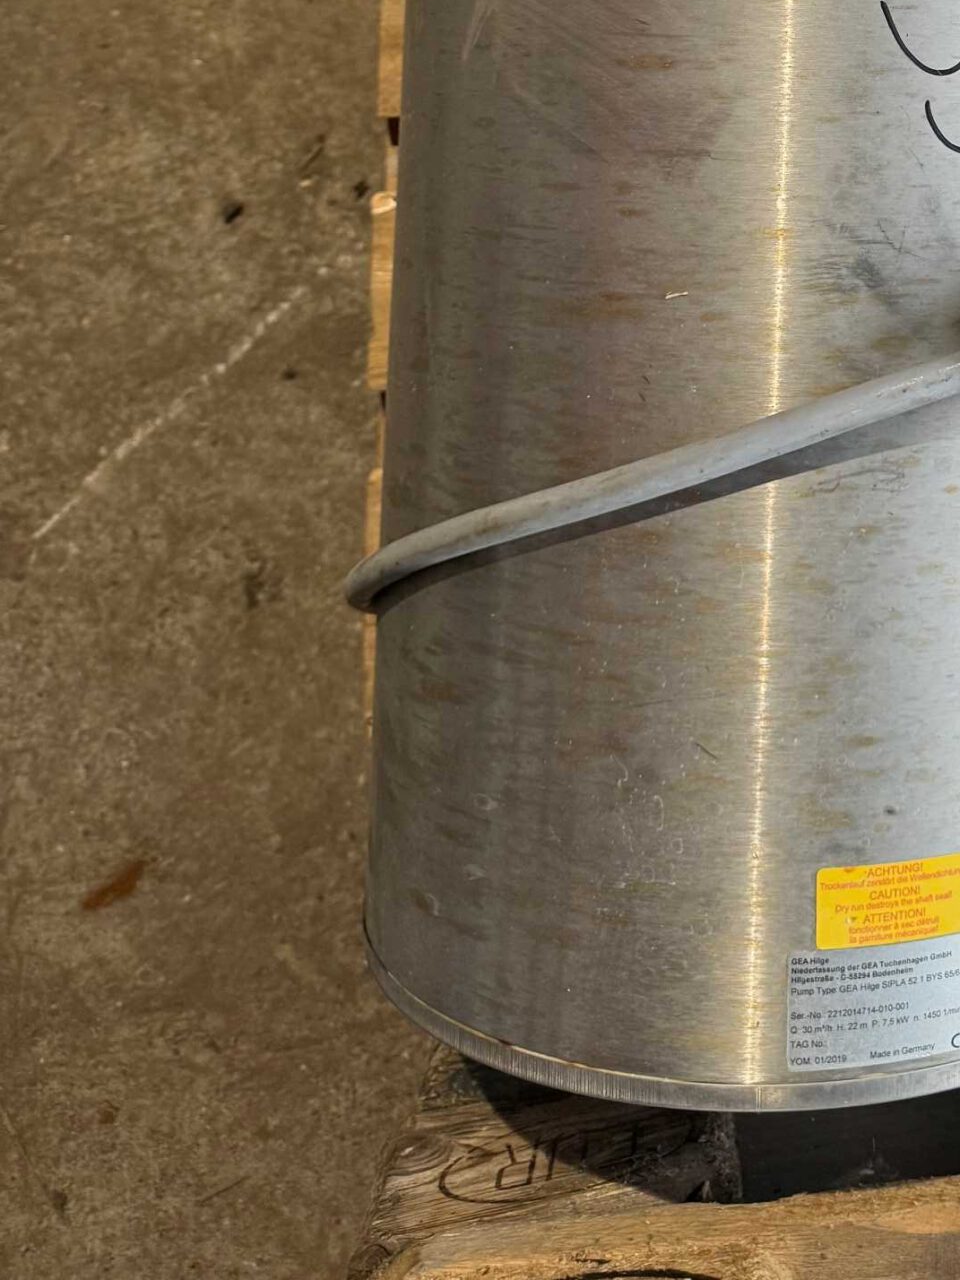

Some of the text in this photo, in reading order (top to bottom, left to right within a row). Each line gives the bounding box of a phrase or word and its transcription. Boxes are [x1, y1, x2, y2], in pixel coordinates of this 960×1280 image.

[867, 862, 924, 878] ACHTUNG!
[868, 885, 921, 900] CAUTION!
[835, 904, 849, 914] Dry
[850, 903, 865, 912] run
[866, 900, 899, 910] destroys
[900, 897, 913, 906] the
[862, 907, 926, 924] ATTENTION!
[791, 957, 830, 966] GEA Hilge
[791, 950, 953, 975] Niederlassung der GEA Tuchenhagen GmbH
[872, 966, 914, 979] Bodenheim
[791, 986, 815, 996] Pump
[839, 983, 858, 993] GEA
[860, 981, 880, 992] Hilge
[882, 977, 907, 990] SIPLA
[926, 971, 943, 982] BYS
[802, 1025, 813, 1034] 30
[848, 1022, 858, 1031] 22
[896, 1015, 910, 1025] kW
[924, 1009, 941, 1020] 1450
[790, 1040, 809, 1049] TAG
[814, 1054, 847, 1065] 01/2019
[870, 1049, 891, 1059] Made
[902, 1042, 935, 1055] Germany
